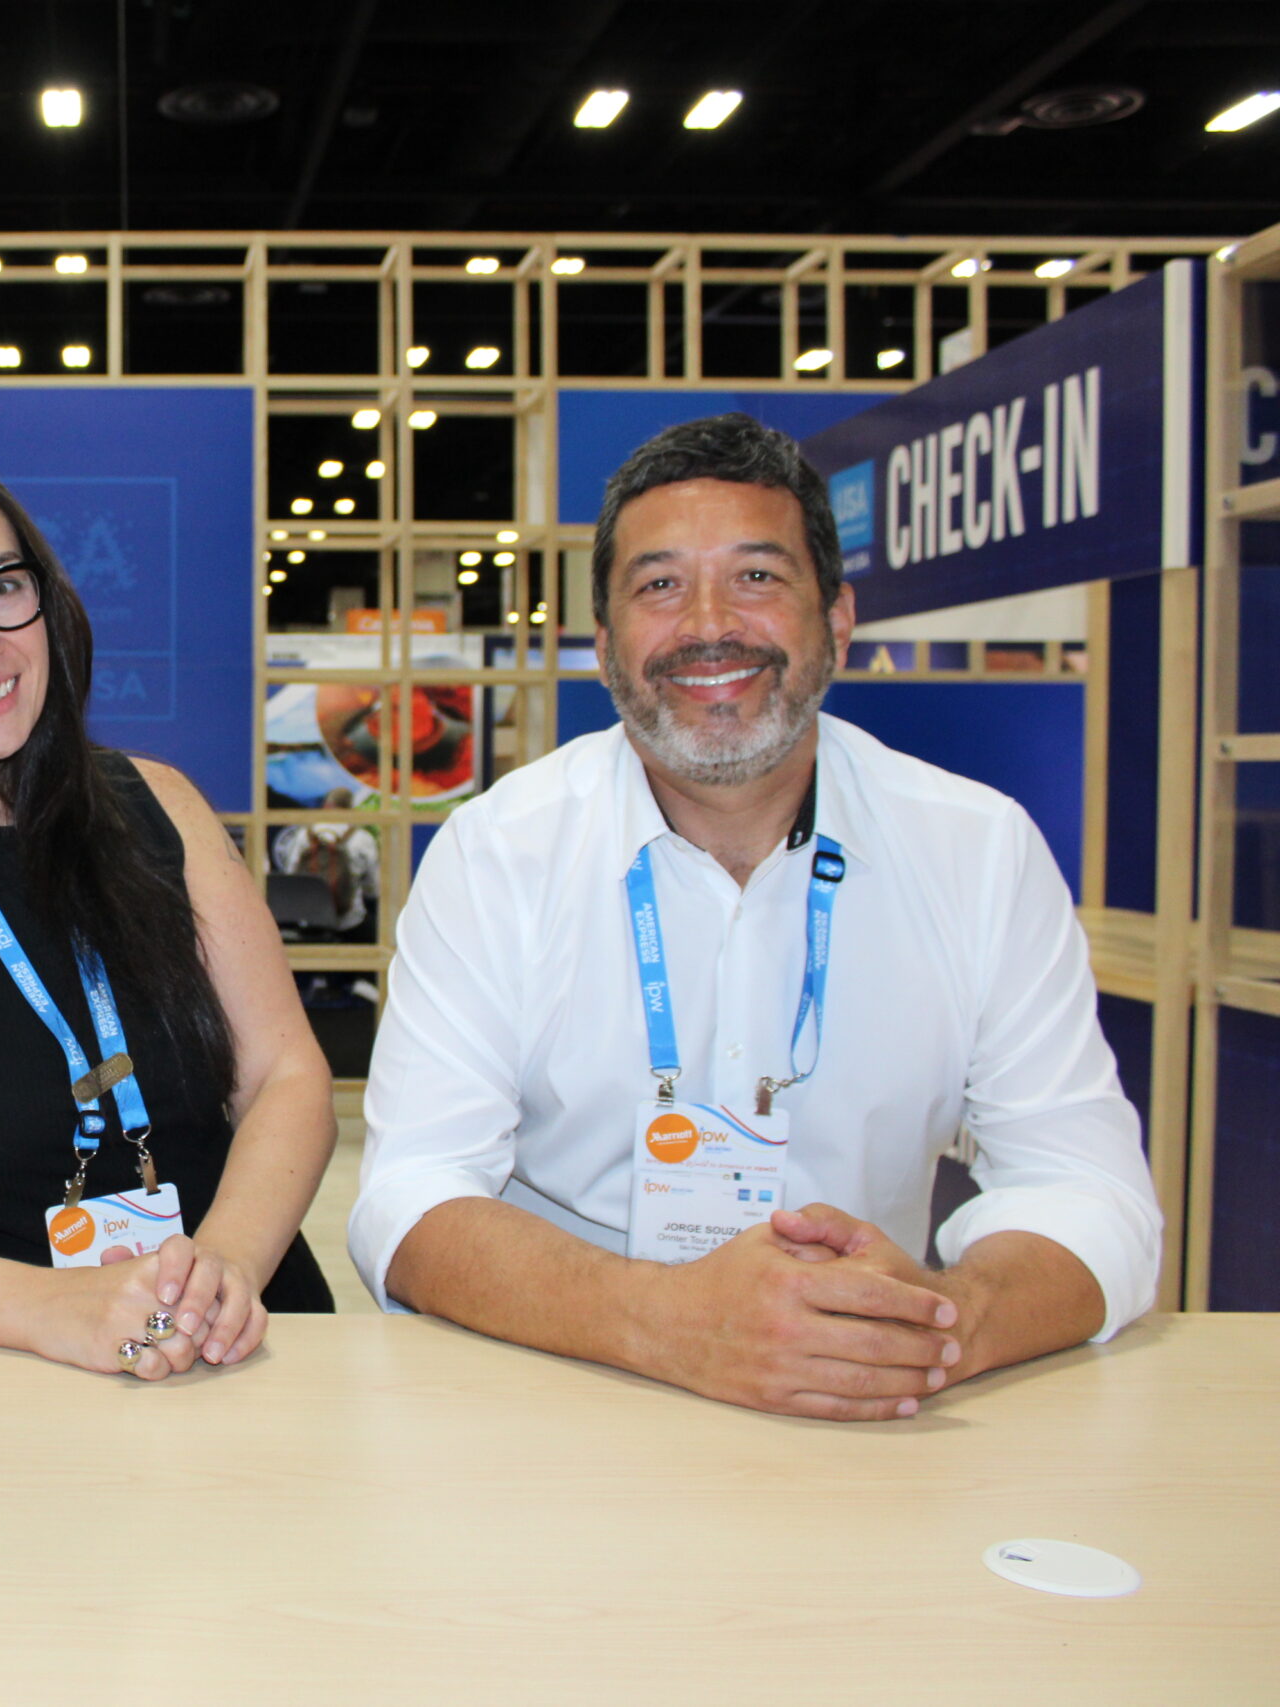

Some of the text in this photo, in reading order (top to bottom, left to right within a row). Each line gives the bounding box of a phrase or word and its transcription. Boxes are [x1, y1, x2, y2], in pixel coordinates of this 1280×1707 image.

[886, 365, 1100, 571] CHECK-IN
[94, 670, 146, 699] SA
[634, 910, 652, 965] EXPRESS
[642, 901, 661, 963] AMERICAN
[10, 963, 48, 1013] AMERICAN
[18, 961, 49, 1006] EXPRESS
[644, 980, 667, 1013] ipw
[89, 989, 109, 1039] EXPRESS
[699, 1126, 729, 1145] ipw
[644, 1178, 670, 1194] ipw
[103, 1218, 129, 1236] ipw
[664, 1223, 702, 1234] JORGE
